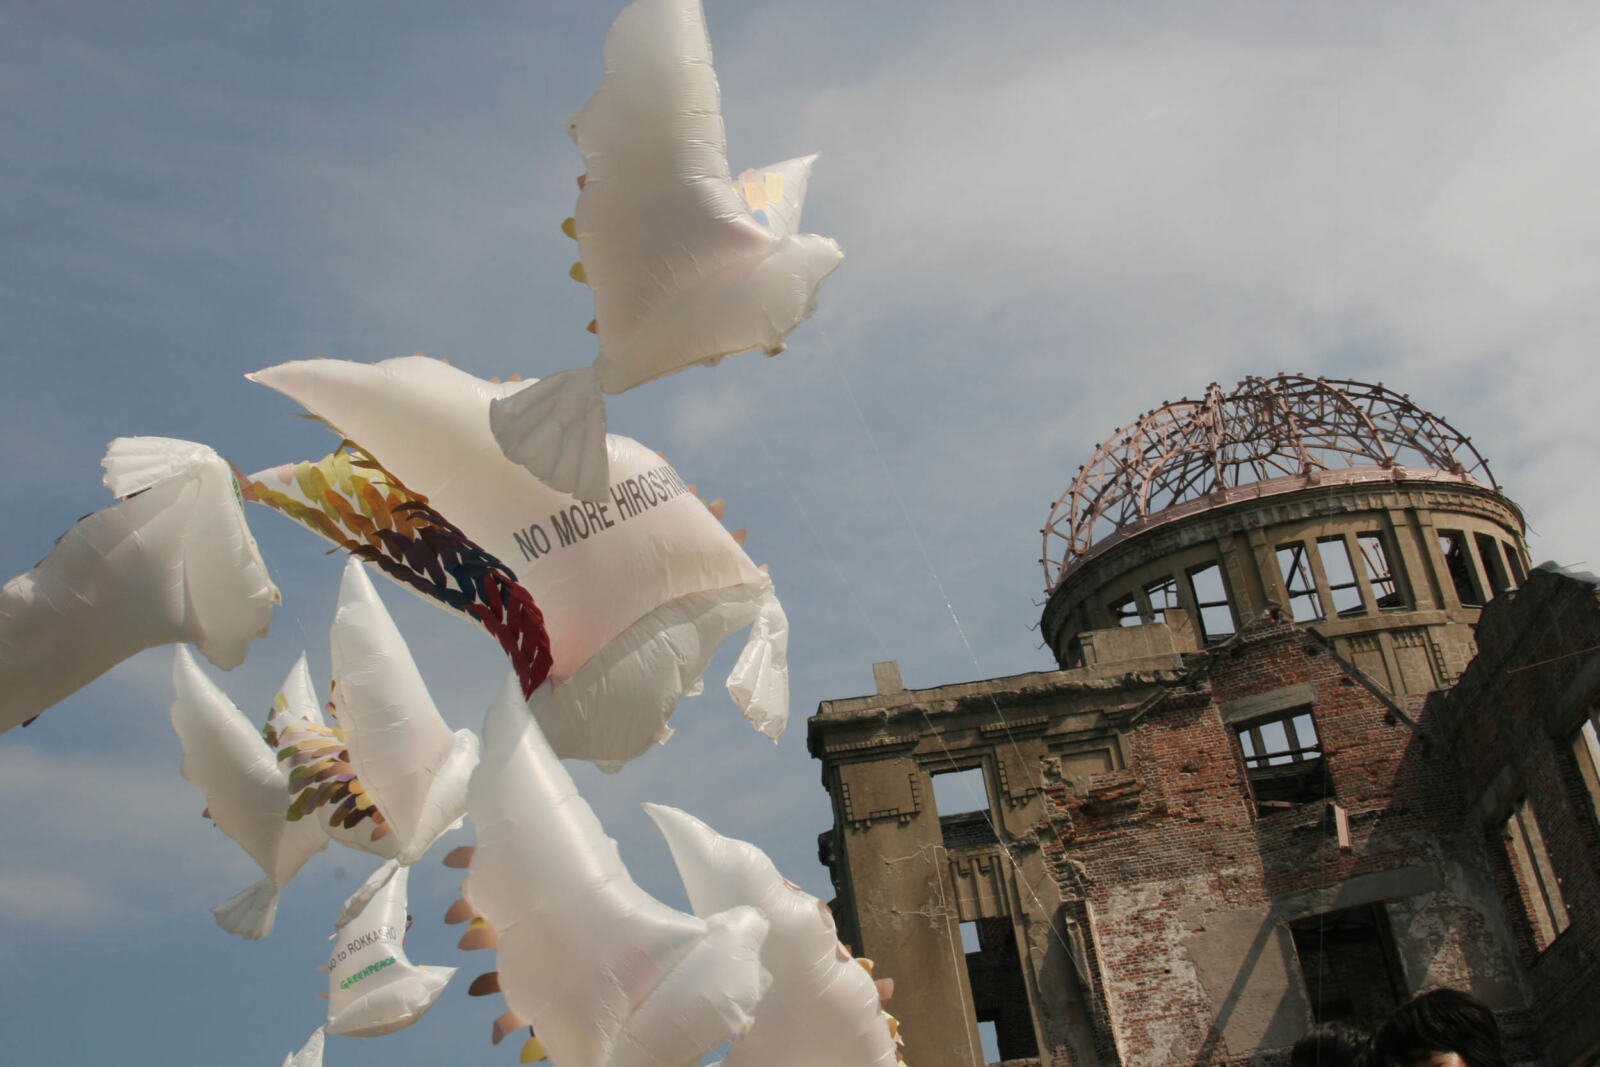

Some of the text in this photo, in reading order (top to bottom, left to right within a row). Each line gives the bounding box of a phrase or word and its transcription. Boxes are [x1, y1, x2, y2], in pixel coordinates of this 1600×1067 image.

[513, 523, 552, 562] NO
[550, 501, 615, 548] MORE
[337, 951, 347, 962] to
[340, 956, 396, 990] GREENPEACE
